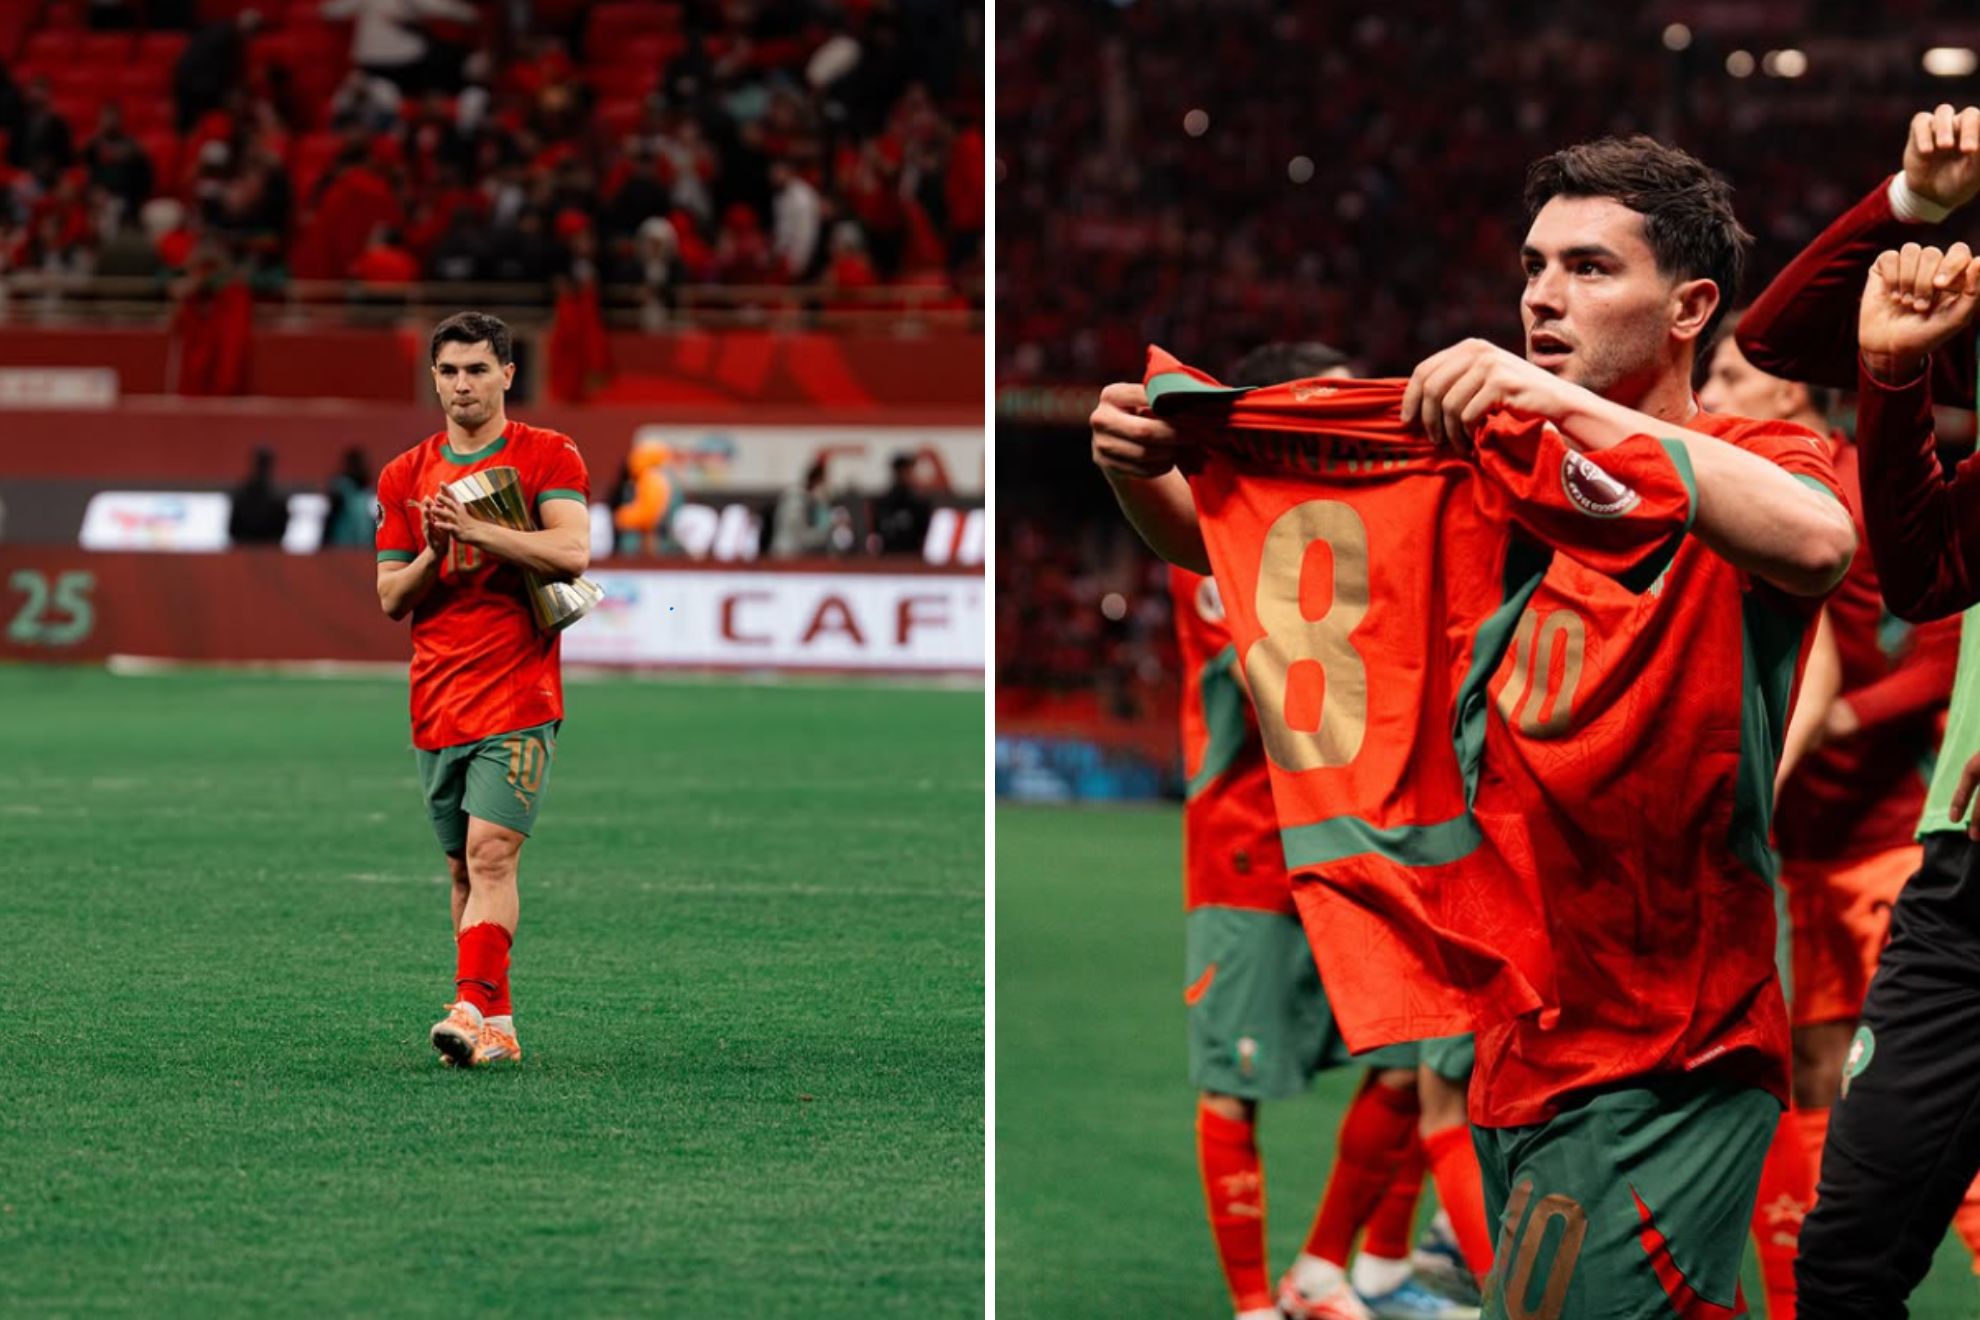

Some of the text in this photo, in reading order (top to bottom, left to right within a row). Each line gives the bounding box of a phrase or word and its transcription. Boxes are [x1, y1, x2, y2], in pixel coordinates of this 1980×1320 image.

[7, 571, 95, 646] 25
[719, 593, 952, 646] CAF
[1246, 499, 1370, 772] 8
[1496, 607, 1585, 738] 10
[502, 736, 545, 793] 10
[1489, 1179, 1588, 1320] 10
